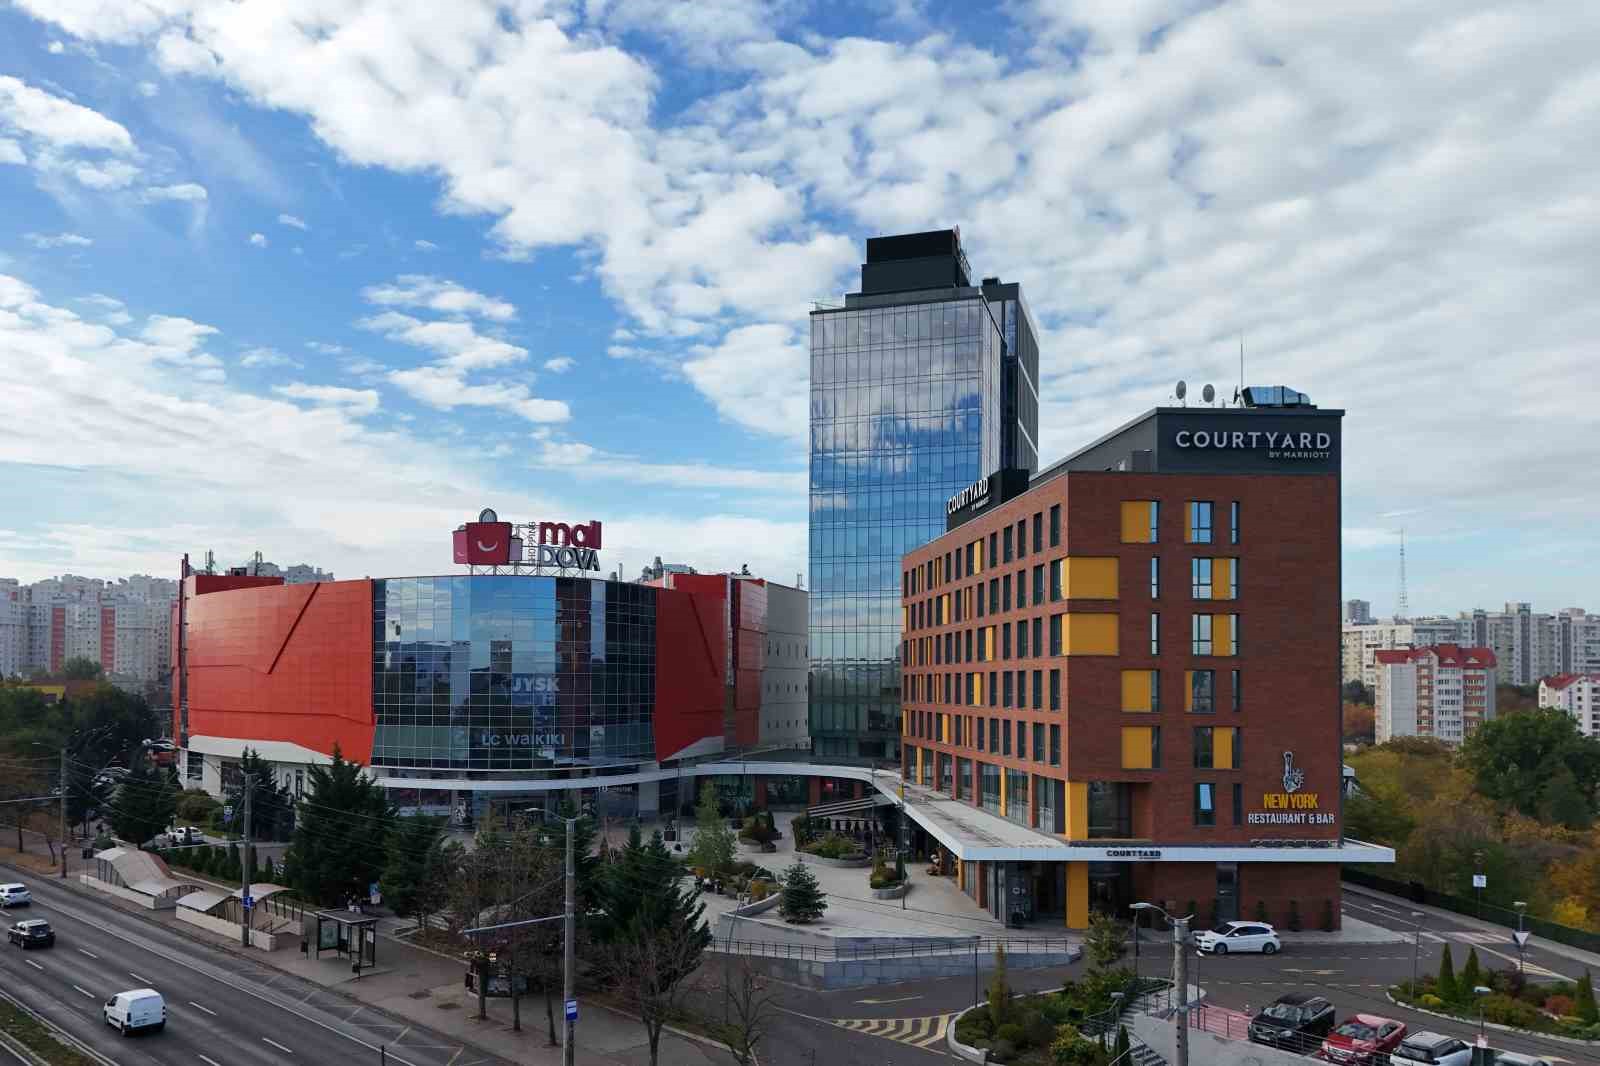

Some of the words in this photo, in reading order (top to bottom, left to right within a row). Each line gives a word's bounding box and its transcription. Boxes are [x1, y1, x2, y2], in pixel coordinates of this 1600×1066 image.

[1175, 431, 1331, 449] COURTYARD
[947, 477, 989, 514] COURTYARD
[539, 544, 601, 571] DOVA
[512, 678, 560, 692] JYSK
[481, 734, 500, 745] LC
[1263, 793, 1288, 809] NEW
[1289, 793, 1319, 809] YORK
[1248, 813, 1306, 824] RESTAURANT
[1308, 813, 1315, 824] &
[1316, 813, 1335, 824] BAR
